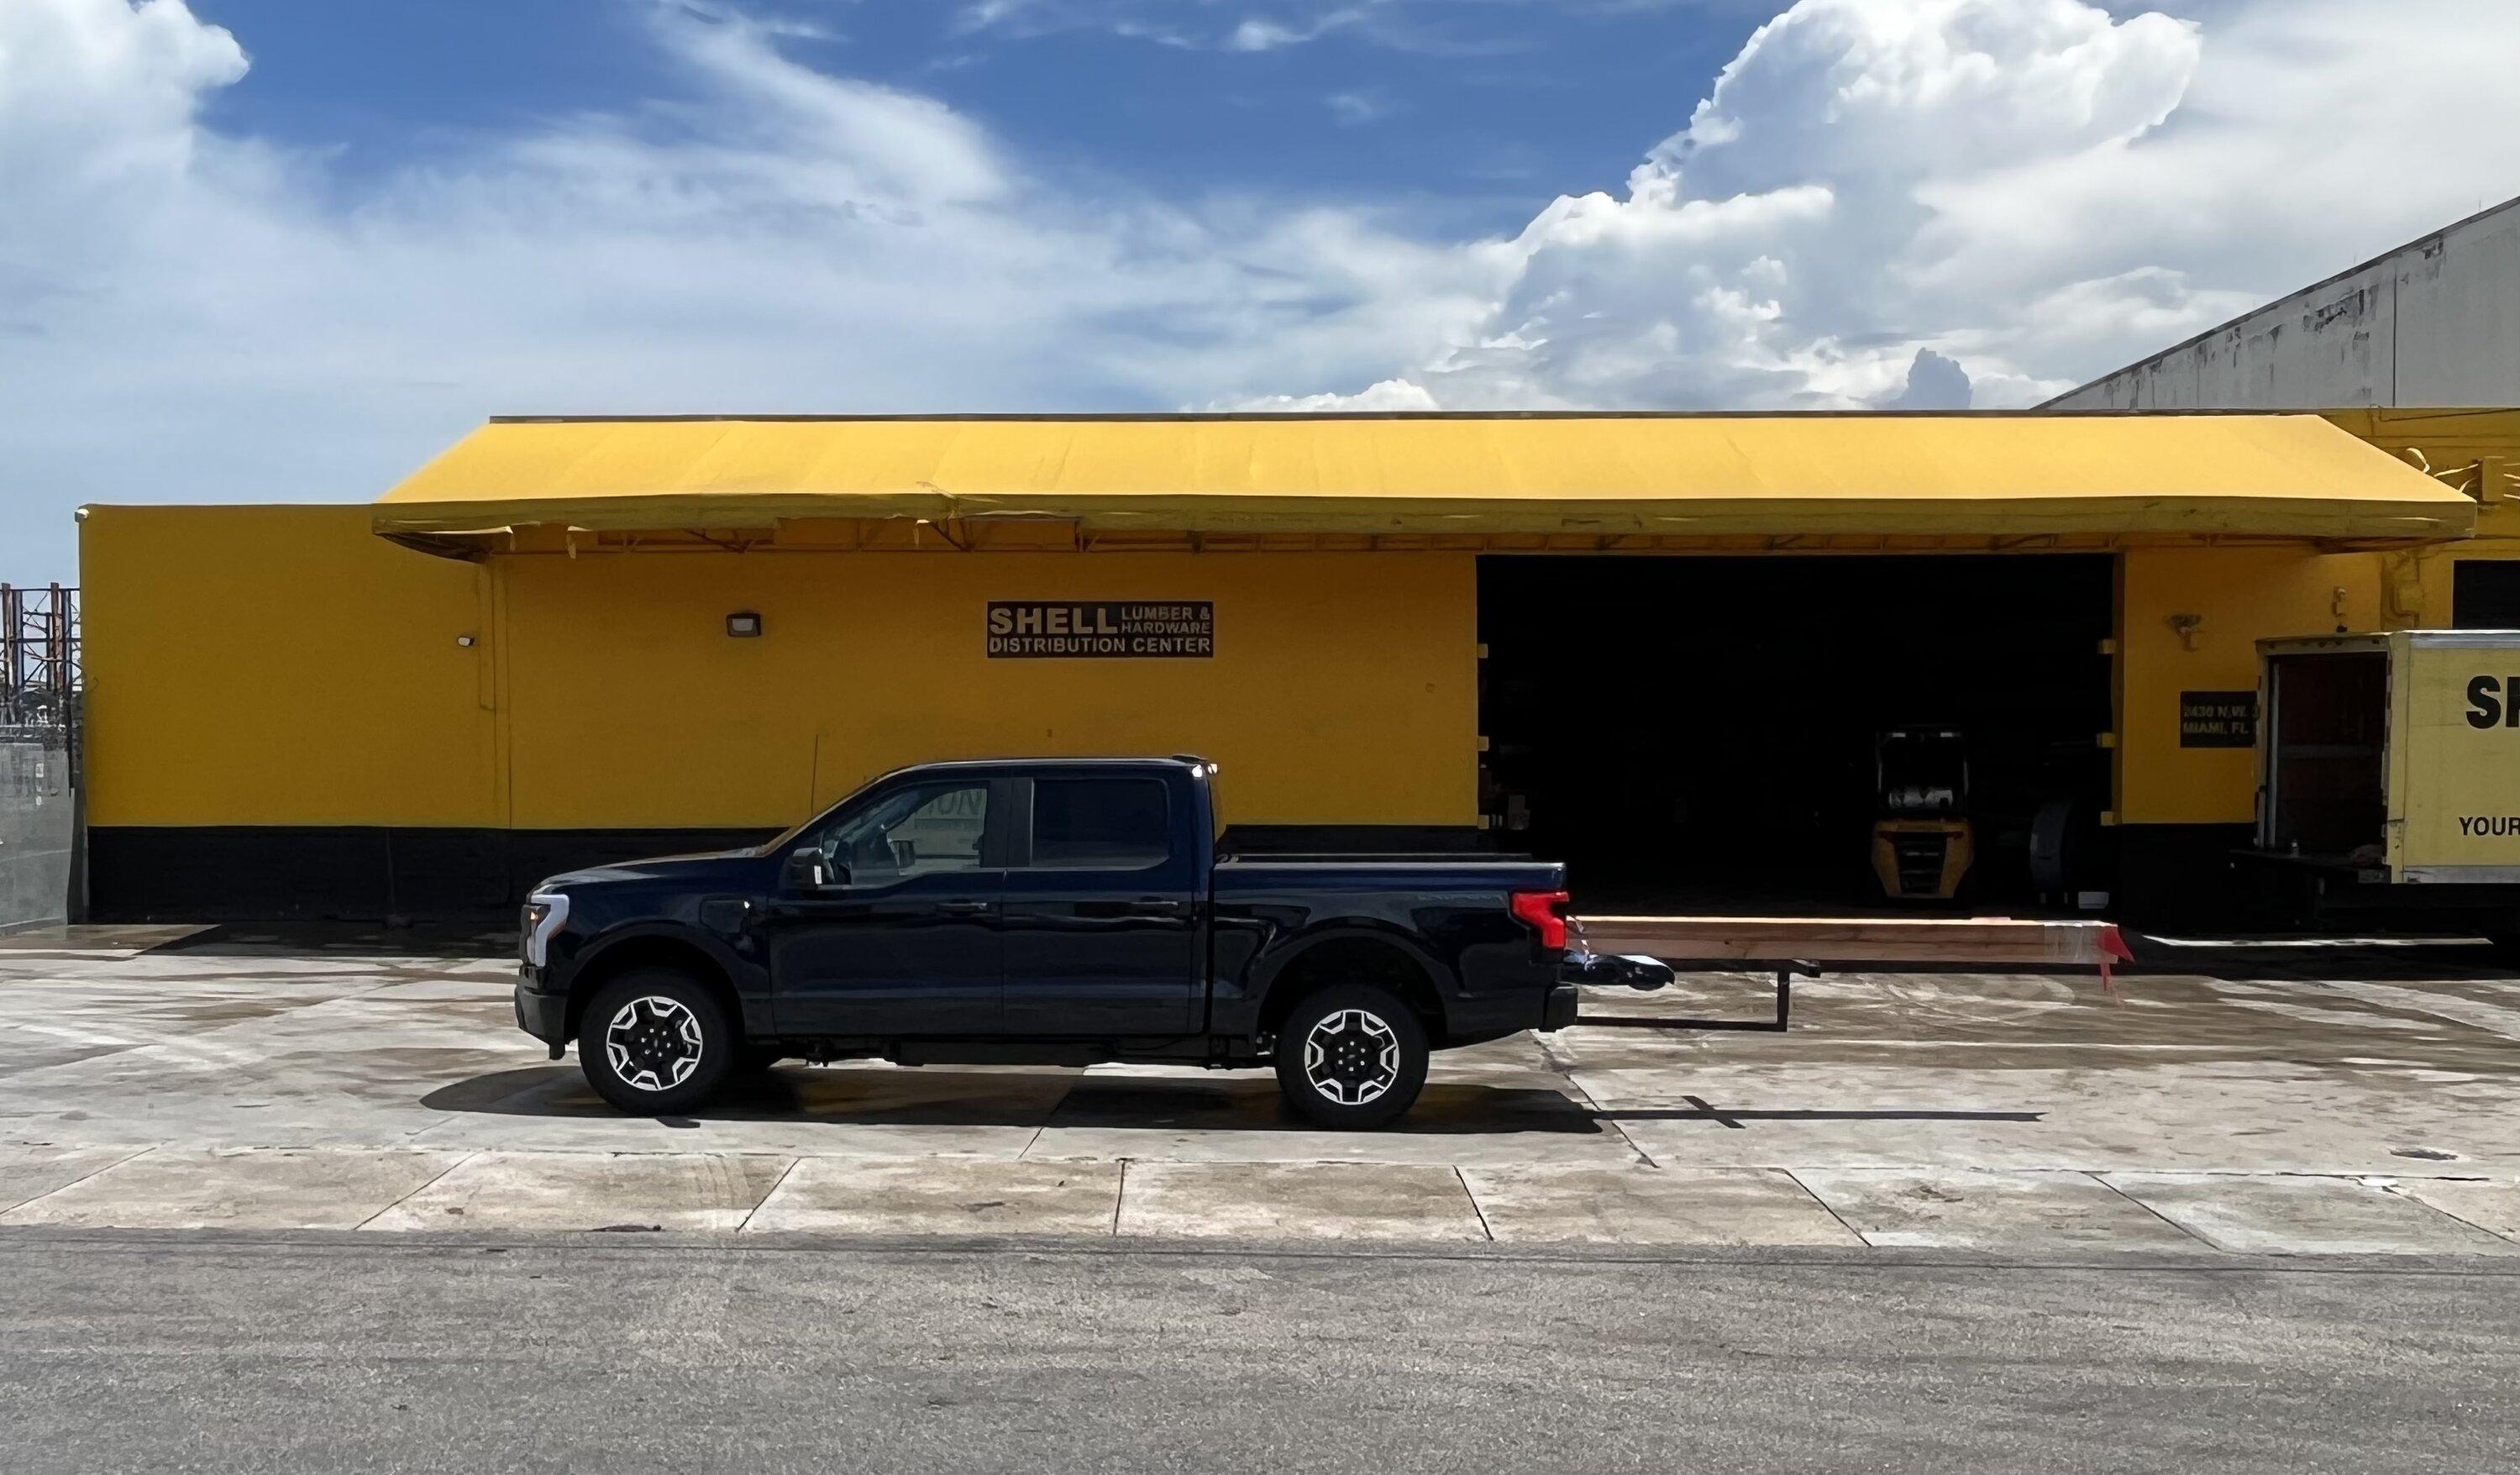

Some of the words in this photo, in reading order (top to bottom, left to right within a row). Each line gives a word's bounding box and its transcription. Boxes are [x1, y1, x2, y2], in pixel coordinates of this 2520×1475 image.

[1121, 606, 1193, 620] LUMBER
[1200, 606, 1210, 620] &
[989, 607, 1118, 634] SHELL
[1121, 622, 1211, 633] HARDWARE
[989, 638, 1126, 653] DISTRIBUTION
[1133, 638, 1211, 653] CENTER
